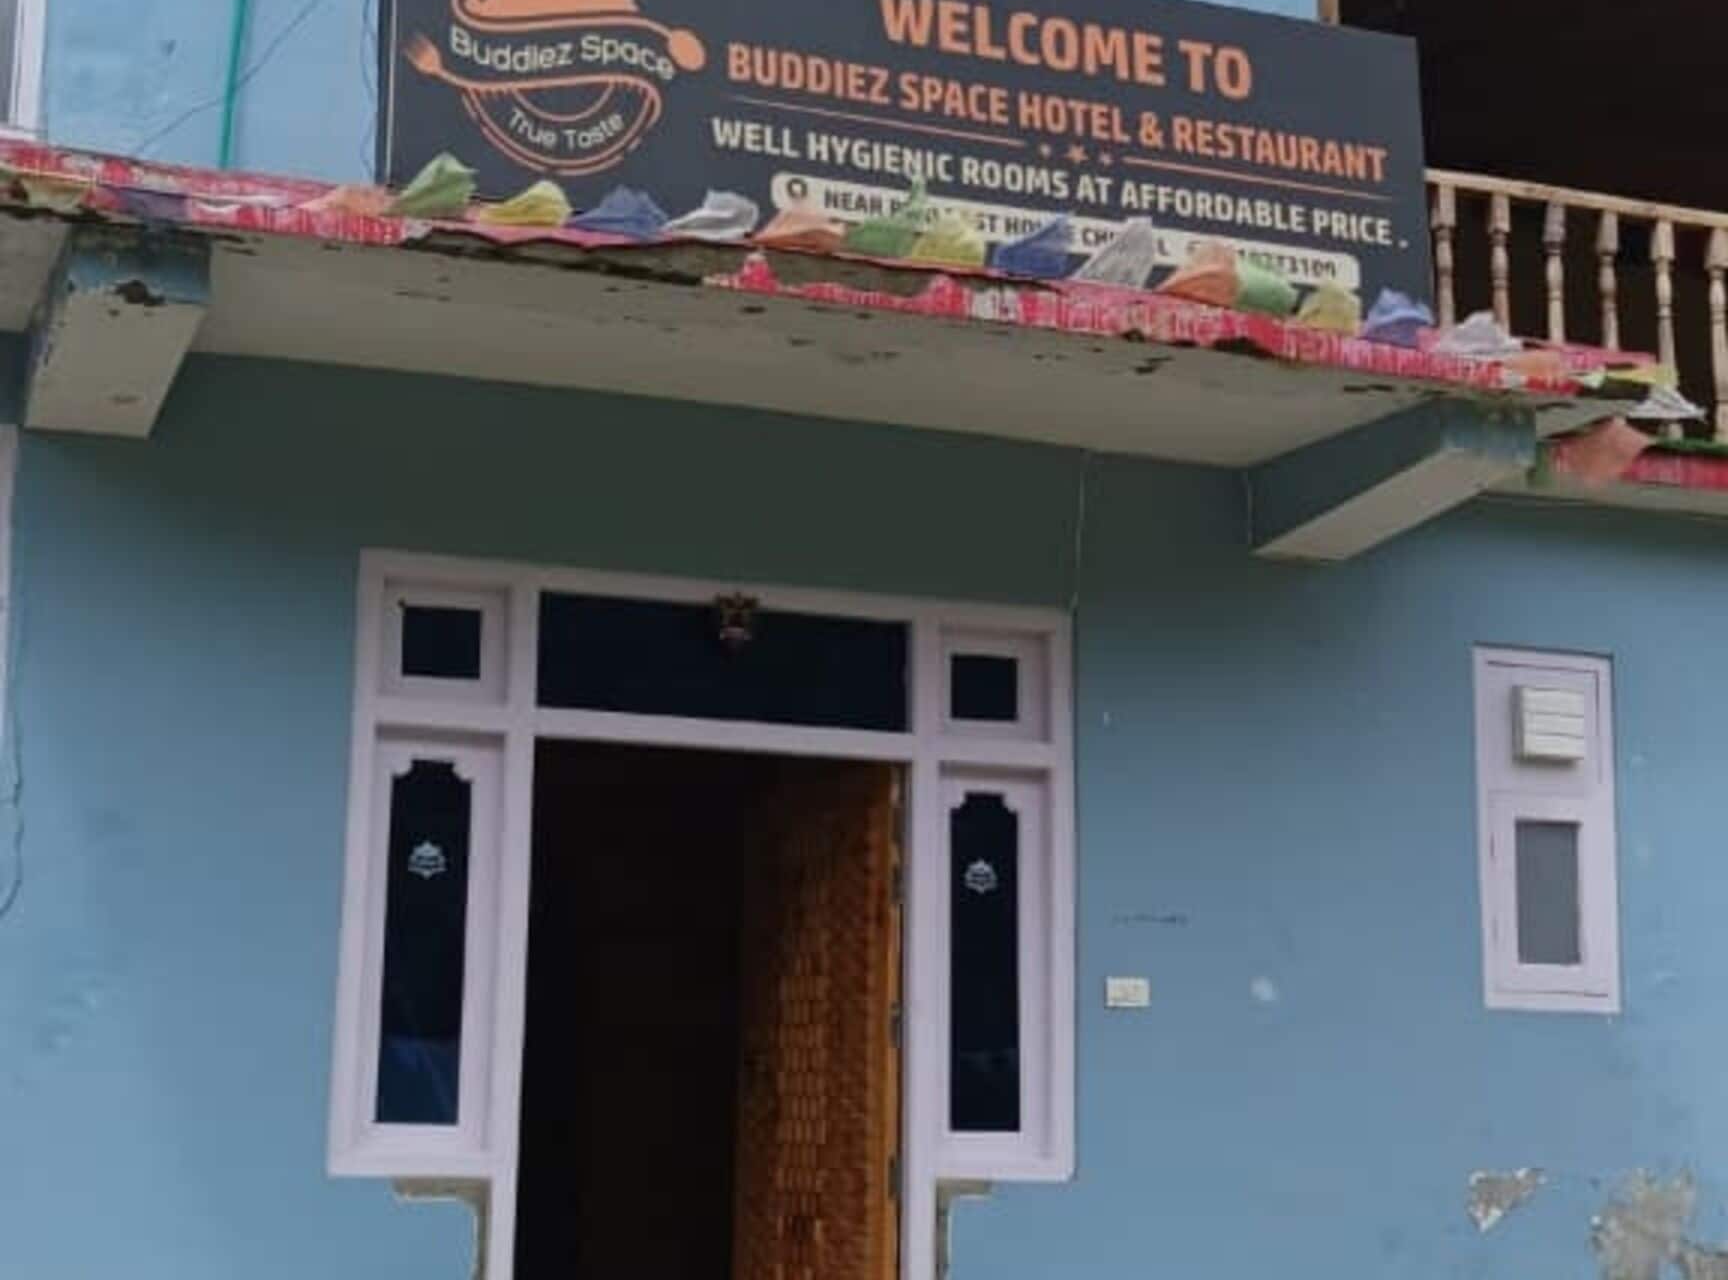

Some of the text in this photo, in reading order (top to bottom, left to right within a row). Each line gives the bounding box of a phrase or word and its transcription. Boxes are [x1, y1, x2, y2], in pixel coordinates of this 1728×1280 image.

[580, 35, 675, 80] Space
[1178, 39, 1252, 99] TO
[509, 108, 624, 150] True Taste
[728, 42, 1388, 182] BUDDIEZ SPACE HOTEL & RESTAURANT
[712, 117, 800, 157] WELL
[808, 132, 954, 181] HYGIENIC
[962, 157, 1069, 198] ROOMS
[1077, 173, 1112, 203] AT
[1121, 182, 1307, 232] AFFORDABLE
[824, 190, 882, 214] NEAR
